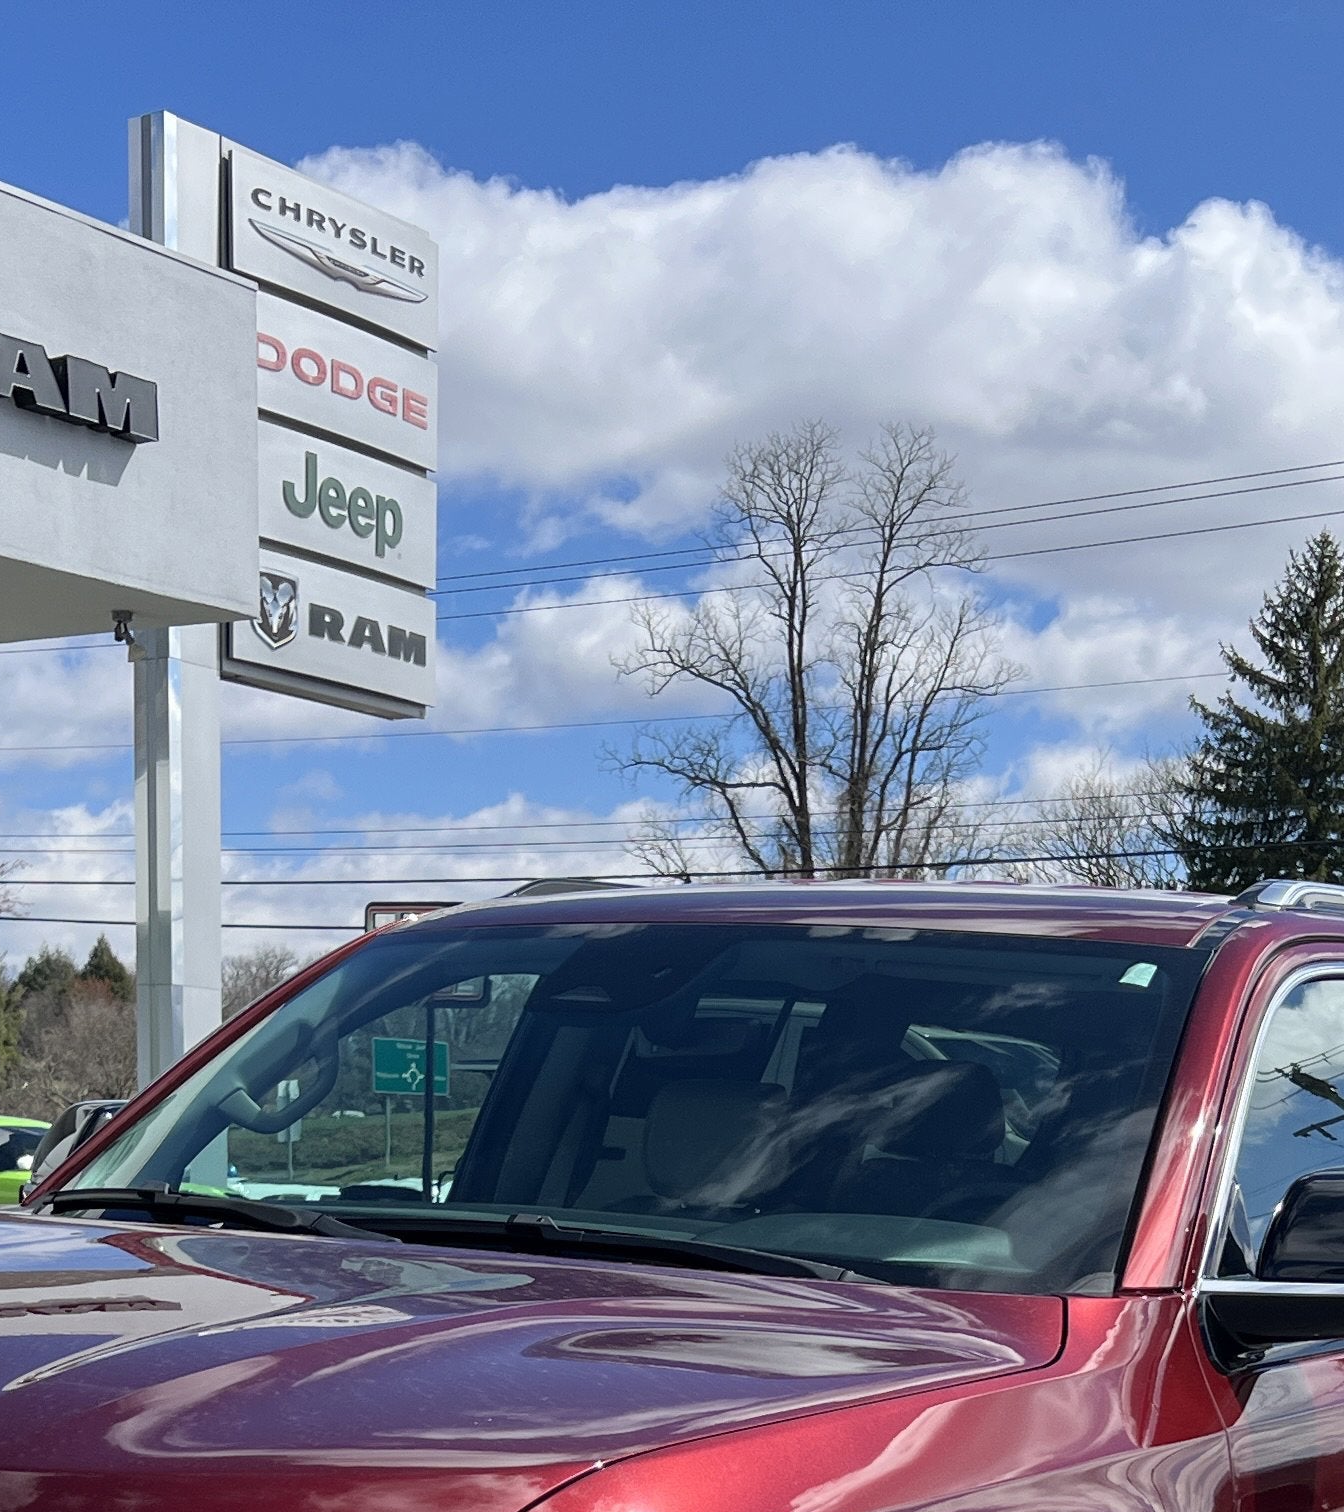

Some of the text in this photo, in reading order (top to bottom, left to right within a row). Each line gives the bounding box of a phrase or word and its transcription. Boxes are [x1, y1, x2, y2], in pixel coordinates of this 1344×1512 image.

[250, 187, 426, 278] CHRYSLER
[256, 332, 429, 431] DODGE
[282, 450, 404, 559] Jeep
[308, 602, 427, 668] RAM
